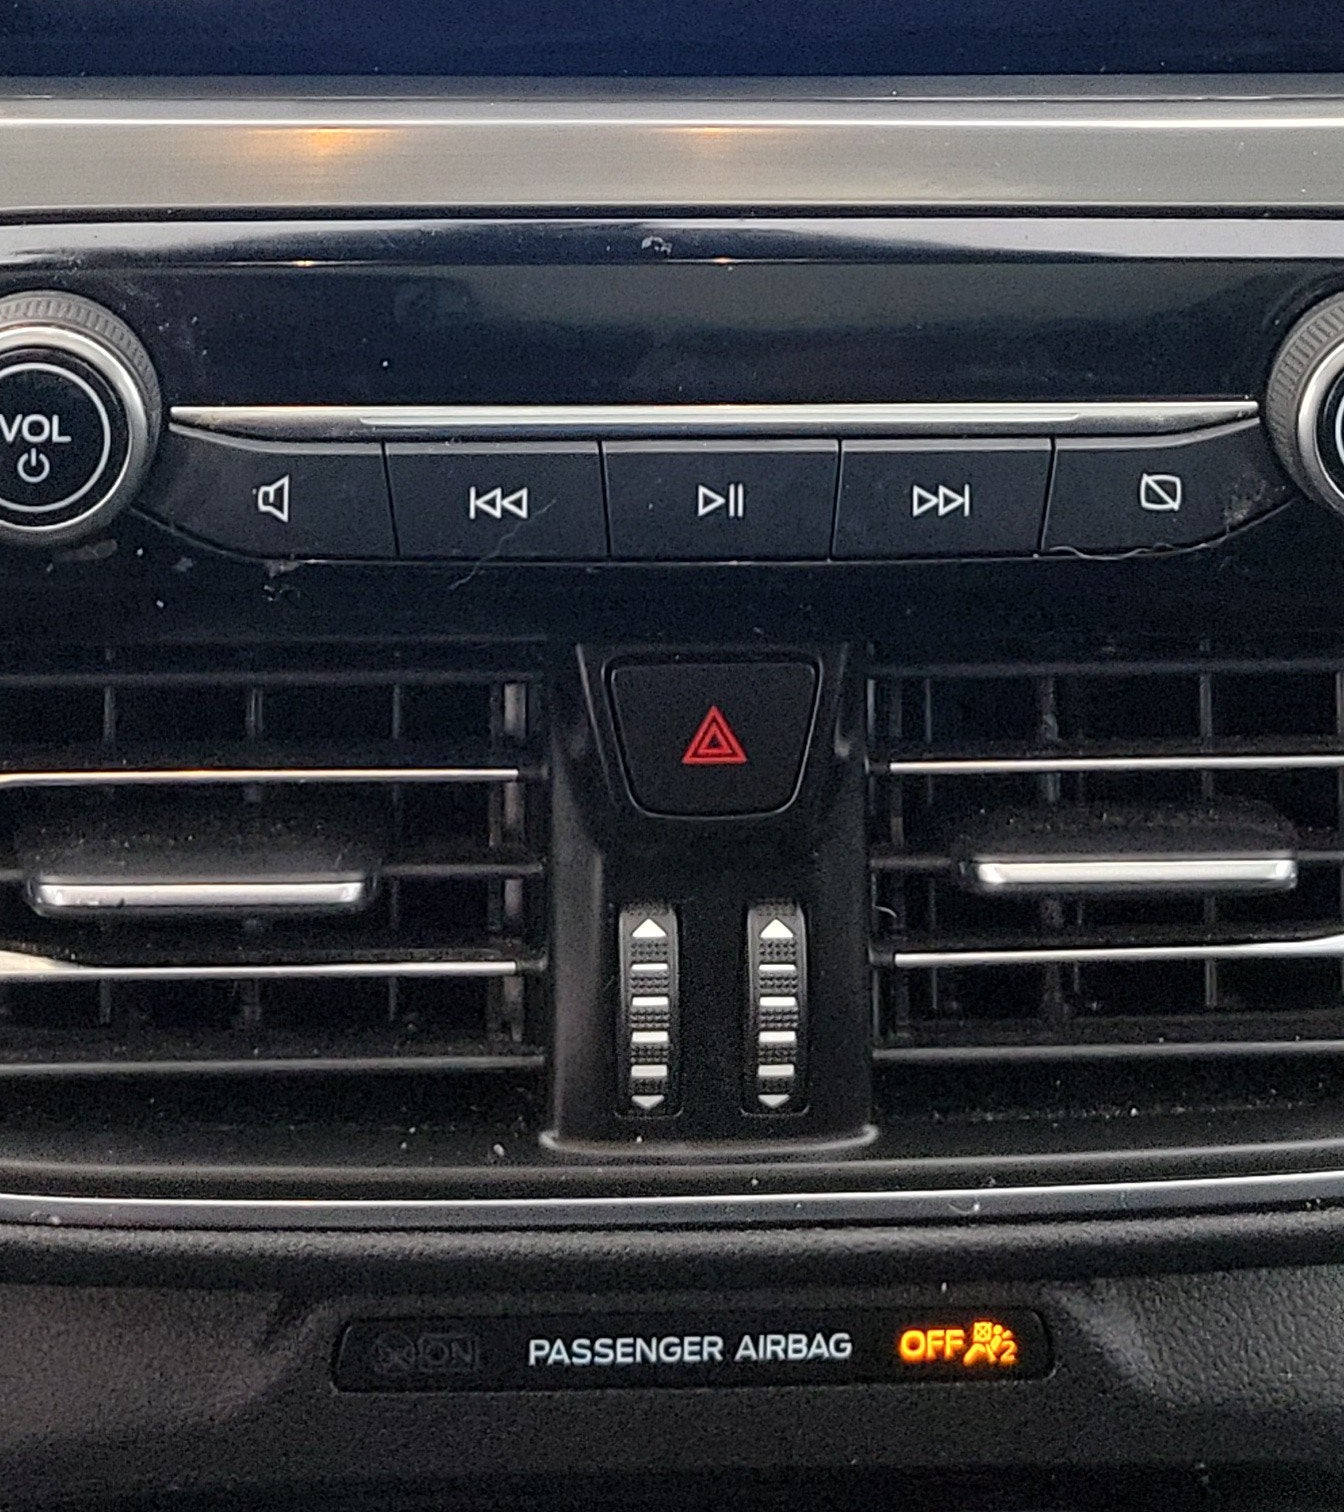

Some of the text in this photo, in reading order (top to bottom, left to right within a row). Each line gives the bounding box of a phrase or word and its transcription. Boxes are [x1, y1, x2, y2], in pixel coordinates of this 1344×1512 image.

[528, 1334, 725, 1366] PASSENGER
[734, 1331, 854, 1362] AIRBAG
[899, 1328, 965, 1362] OFF
